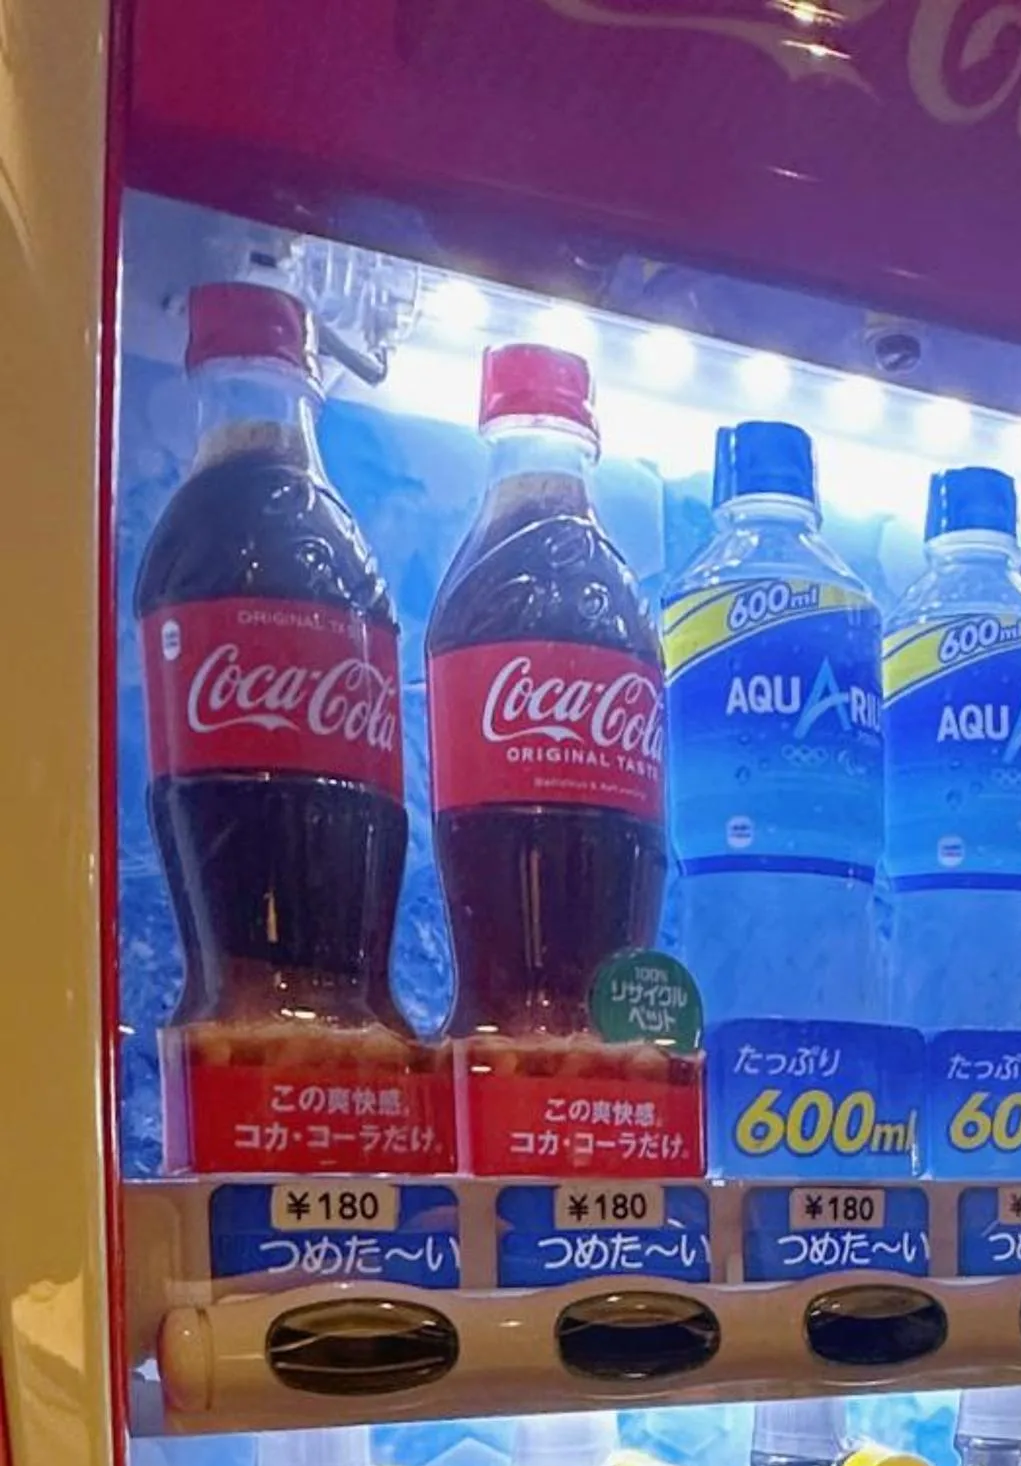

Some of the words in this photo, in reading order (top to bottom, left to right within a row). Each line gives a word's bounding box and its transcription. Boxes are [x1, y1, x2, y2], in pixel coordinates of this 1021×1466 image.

[727, 580, 820, 630] 600ml
[187, 642, 396, 752] Coca-Cola
[506, 745, 611, 768] ORIGINAL
[610, 979, 688, 1008] リサイクル
[628, 1004, 677, 1034] ペット
[733, 1044, 842, 1077] たっぷり
[233, 1121, 442, 1154] コカ・コーラだけ。
[286, 1190, 380, 1222] ¥180
[567, 1193, 647, 1222] ¥180
[804, 1193, 875, 1223] ¥180
